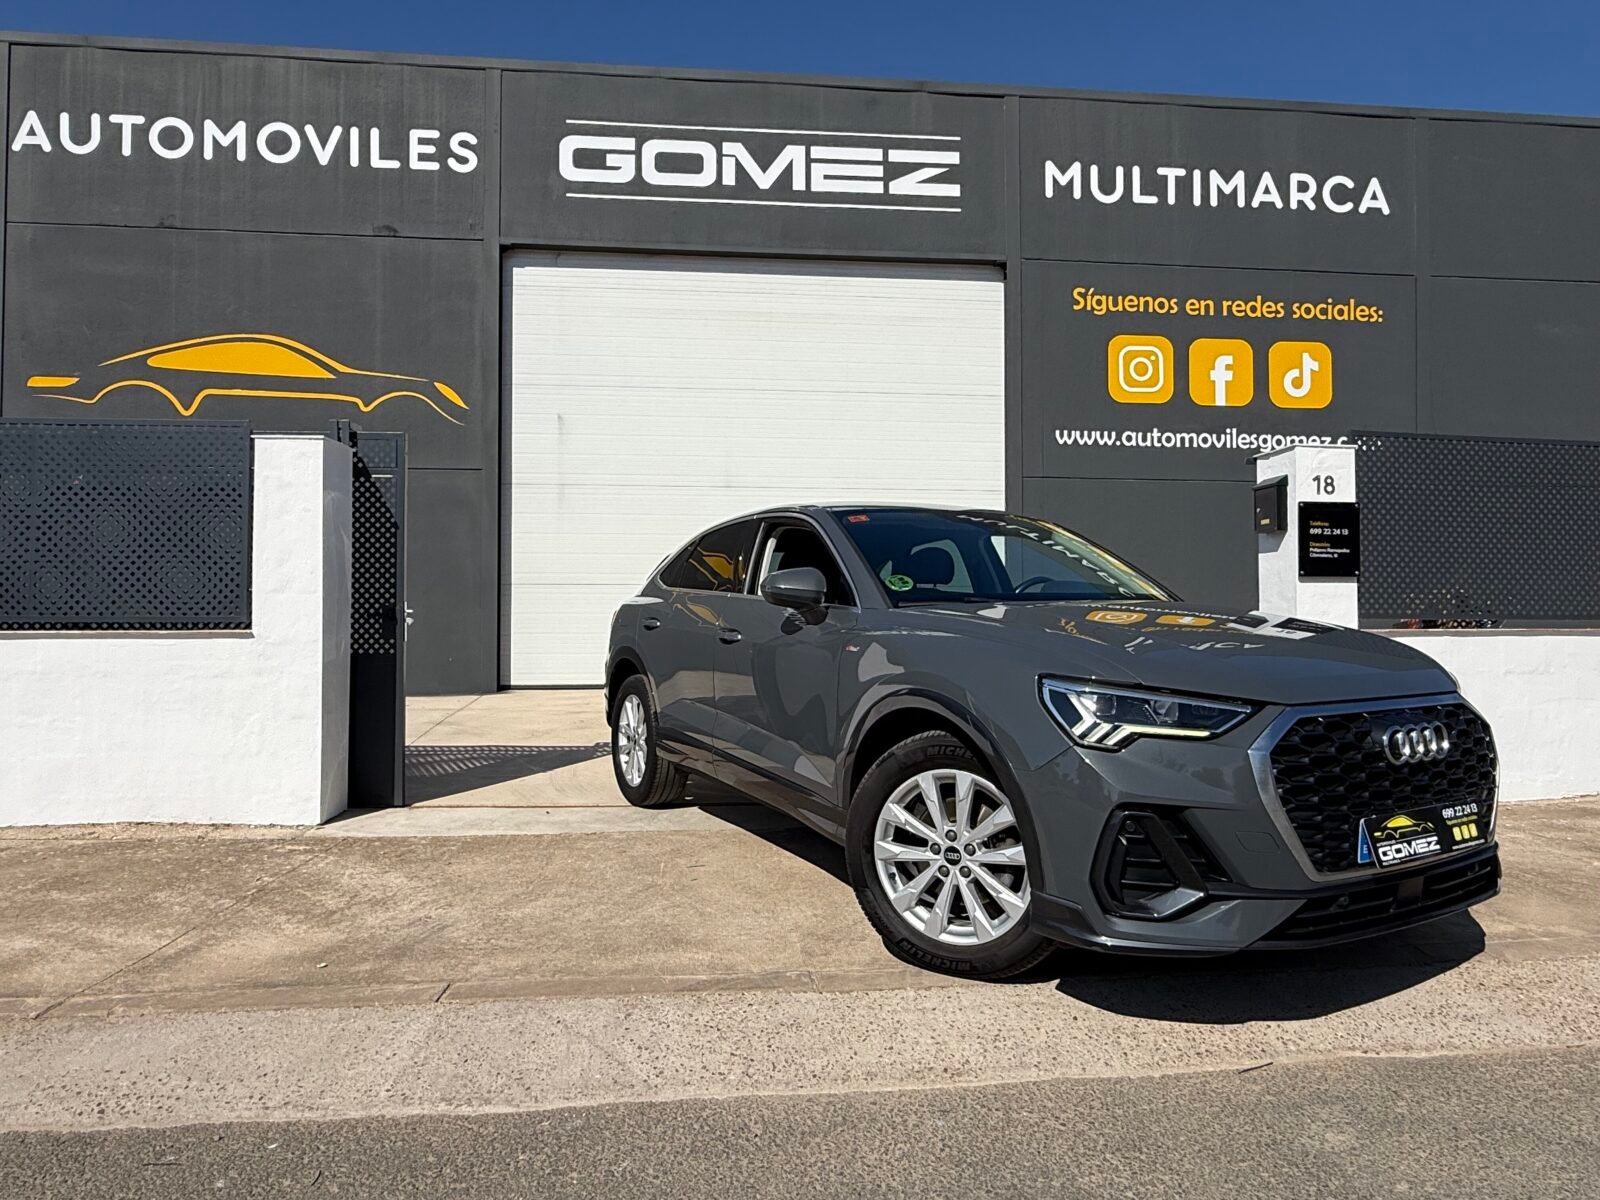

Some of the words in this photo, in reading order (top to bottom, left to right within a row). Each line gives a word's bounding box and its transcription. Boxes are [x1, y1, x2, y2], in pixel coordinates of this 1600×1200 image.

[12, 110, 479, 173] AUTOMOVILES
[559, 135, 961, 197] GOMEZ
[1045, 160, 1390, 216] MULTIMARCA
[1071, 287, 1178, 315] Síguenos
[1185, 298, 1214, 317] en
[1221, 296, 1285, 319] redes
[1292, 298, 1384, 323] sociales:
[1311, 474, 1336, 496] 18
[1341, 528, 1349, 536] 13
[927, 745, 977, 761] MICHE
[1442, 807, 1455, 819] 699
[1454, 805, 1464, 816] 22
[1462, 803, 1472, 815] 24
[1378, 836, 1441, 861] GOMEZ
